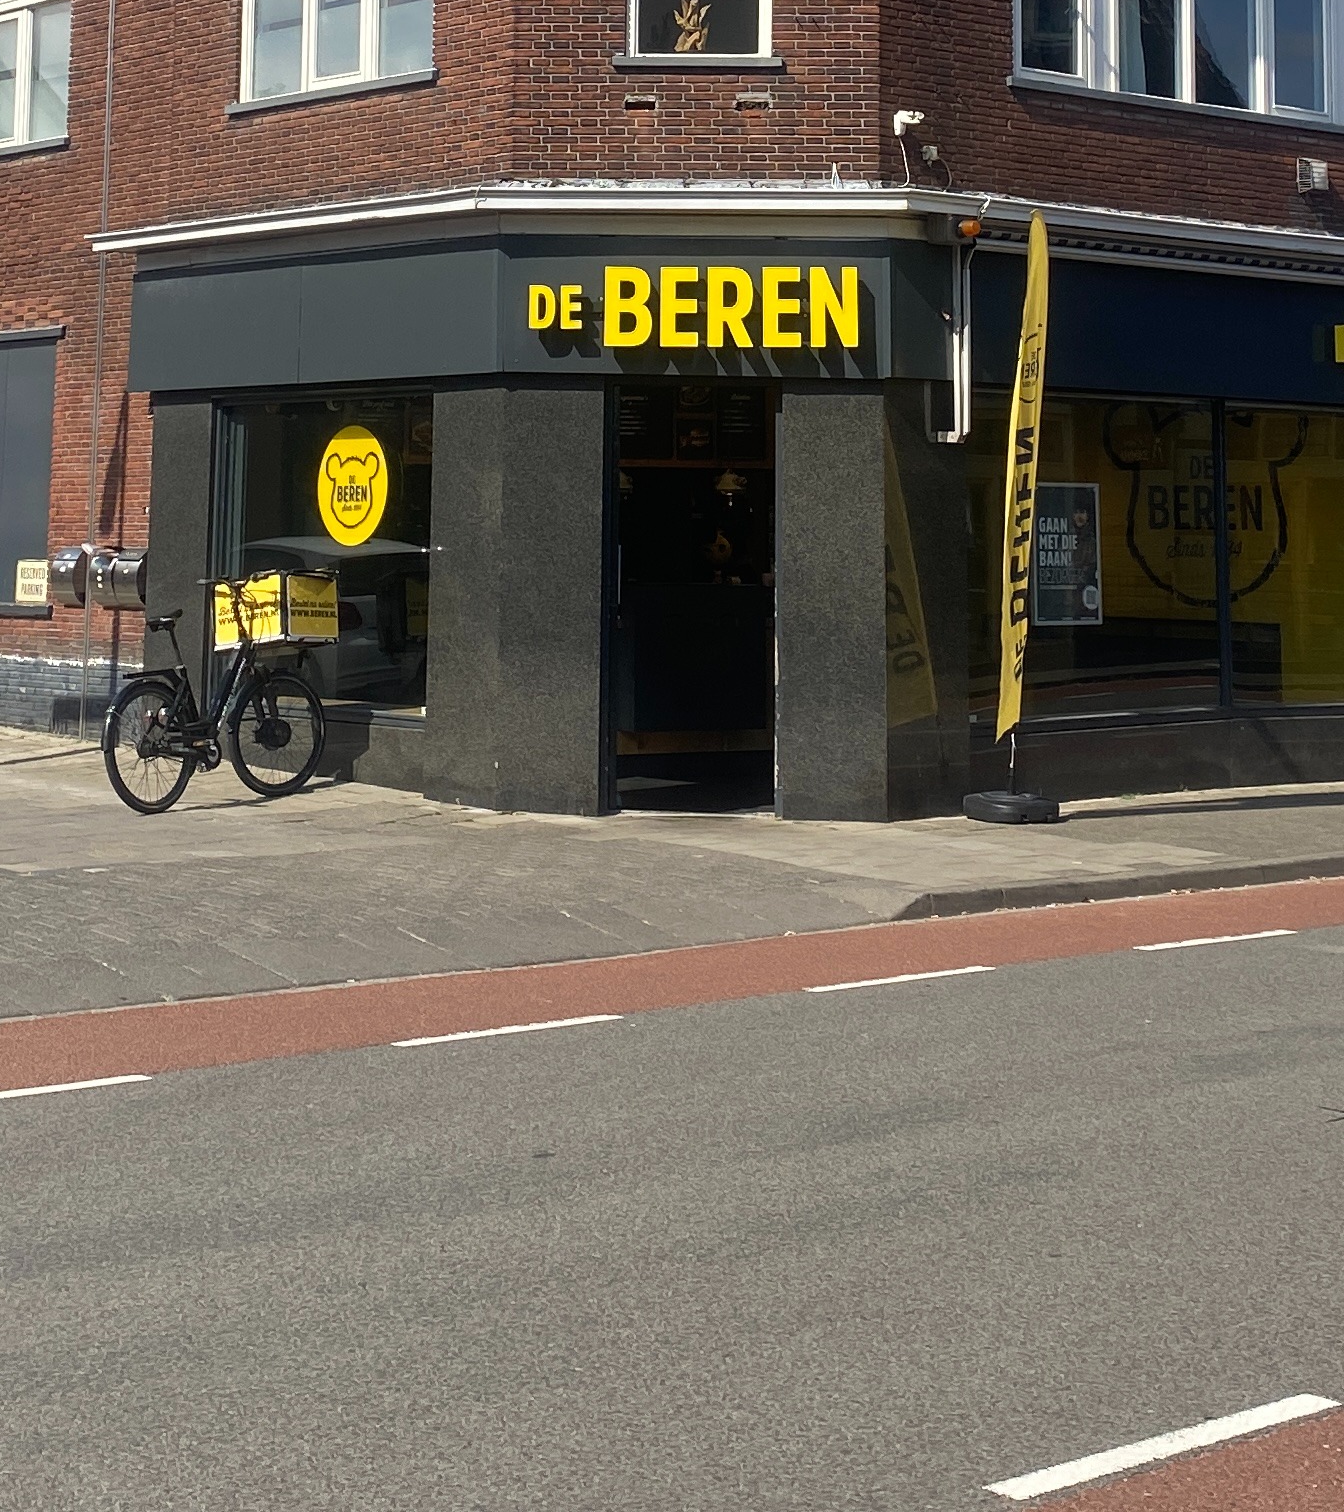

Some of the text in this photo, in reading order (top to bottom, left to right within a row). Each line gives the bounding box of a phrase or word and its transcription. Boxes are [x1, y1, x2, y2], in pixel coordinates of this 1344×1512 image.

[528, 265, 859, 349] DE BEREN
[337, 485, 367, 502] BEREN
[1147, 485, 1263, 531] BEREN
[1038, 517, 1068, 533] GAAN
[1039, 534, 1078, 550] MET DIE
[1039, 551, 1072, 567] BAAN!
